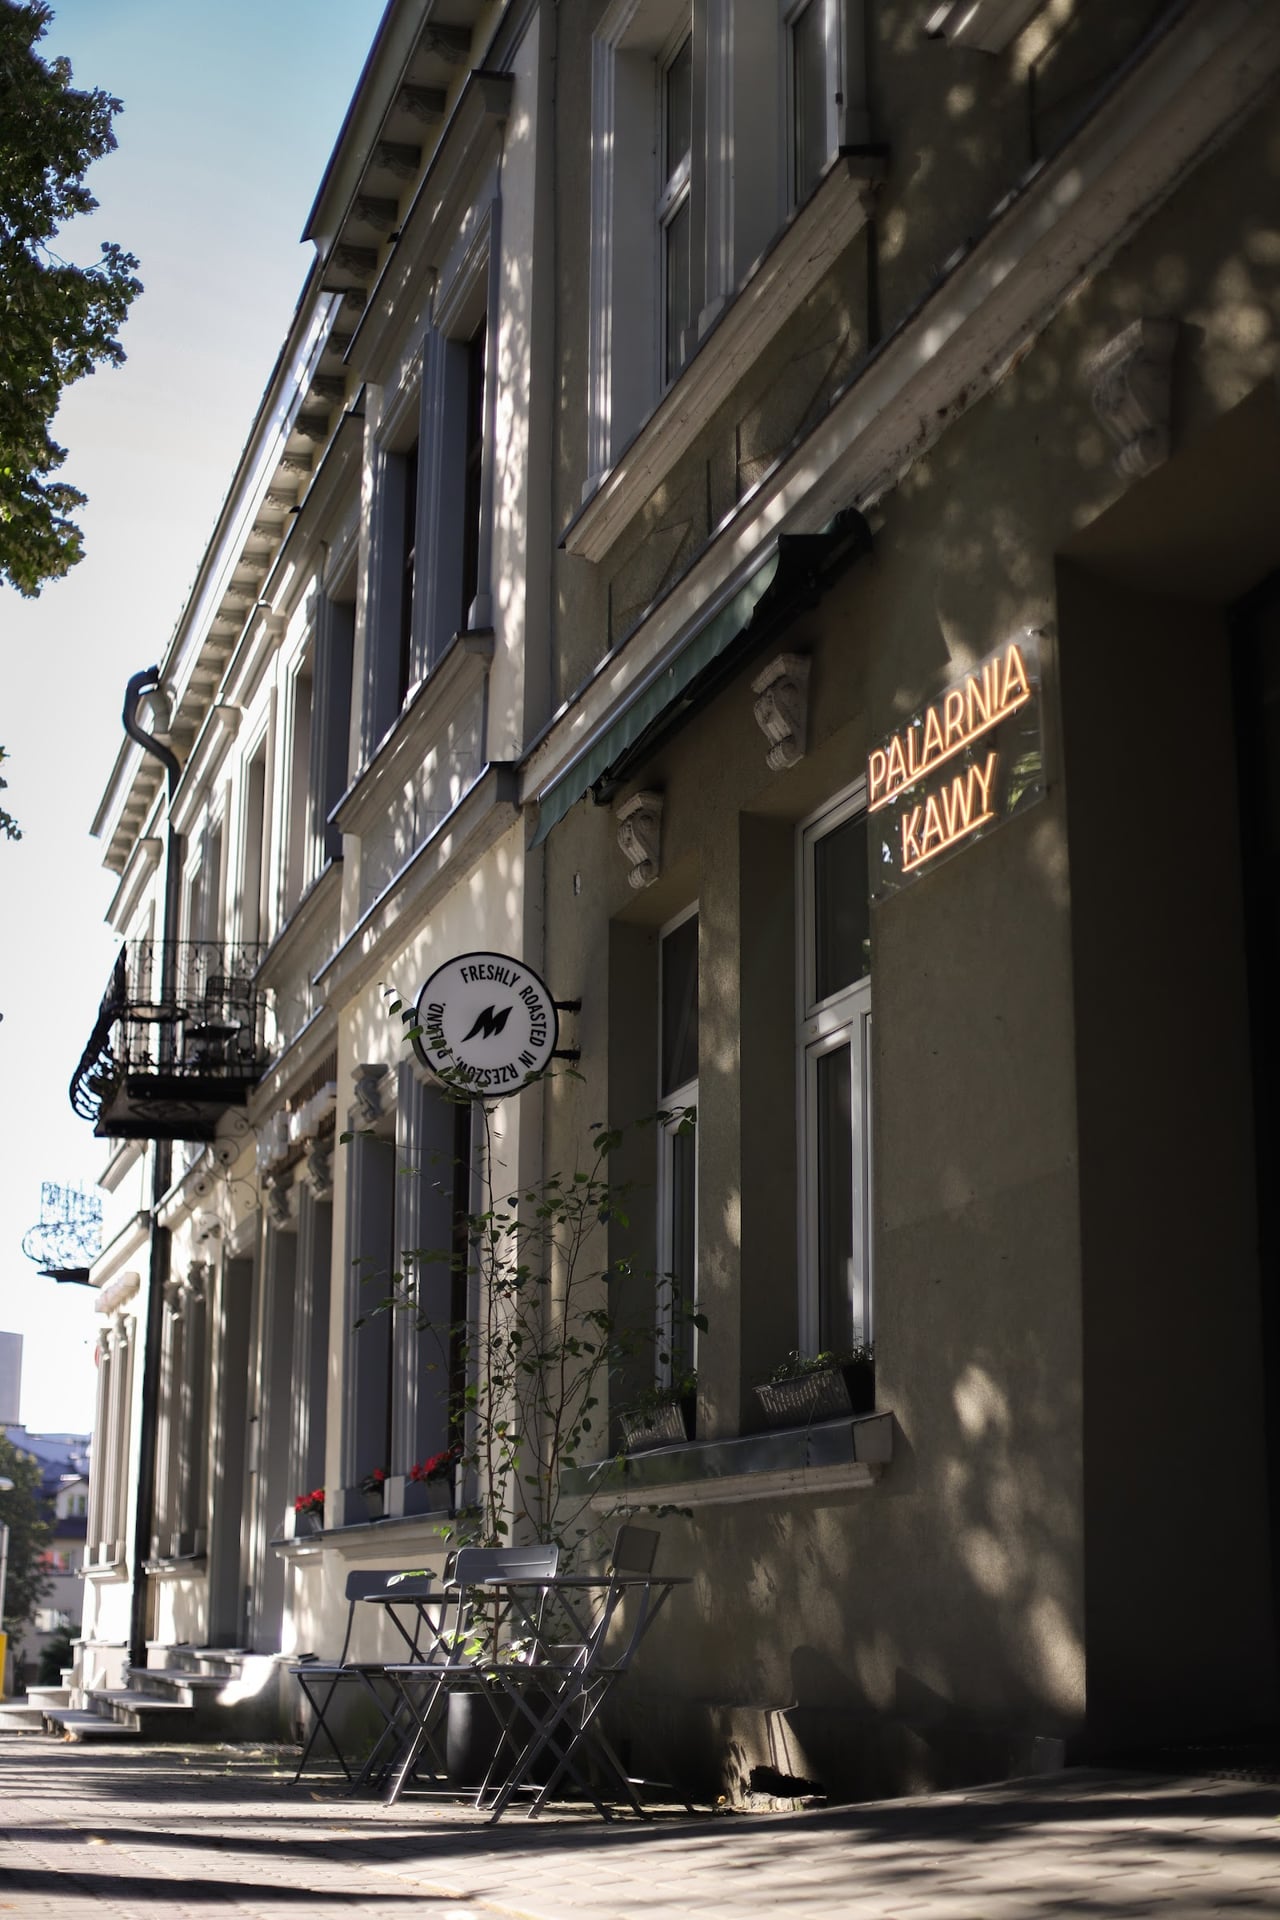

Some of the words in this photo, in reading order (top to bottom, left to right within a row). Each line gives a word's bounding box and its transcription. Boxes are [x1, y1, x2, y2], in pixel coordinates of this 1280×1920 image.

[868, 644, 1029, 802] PALARNIA
[902, 752, 998, 866] KAWY
[460, 964, 521, 988] FRESHLY
[519, 985, 547, 1047] ROASTED
[518, 1050, 537, 1069] IN
